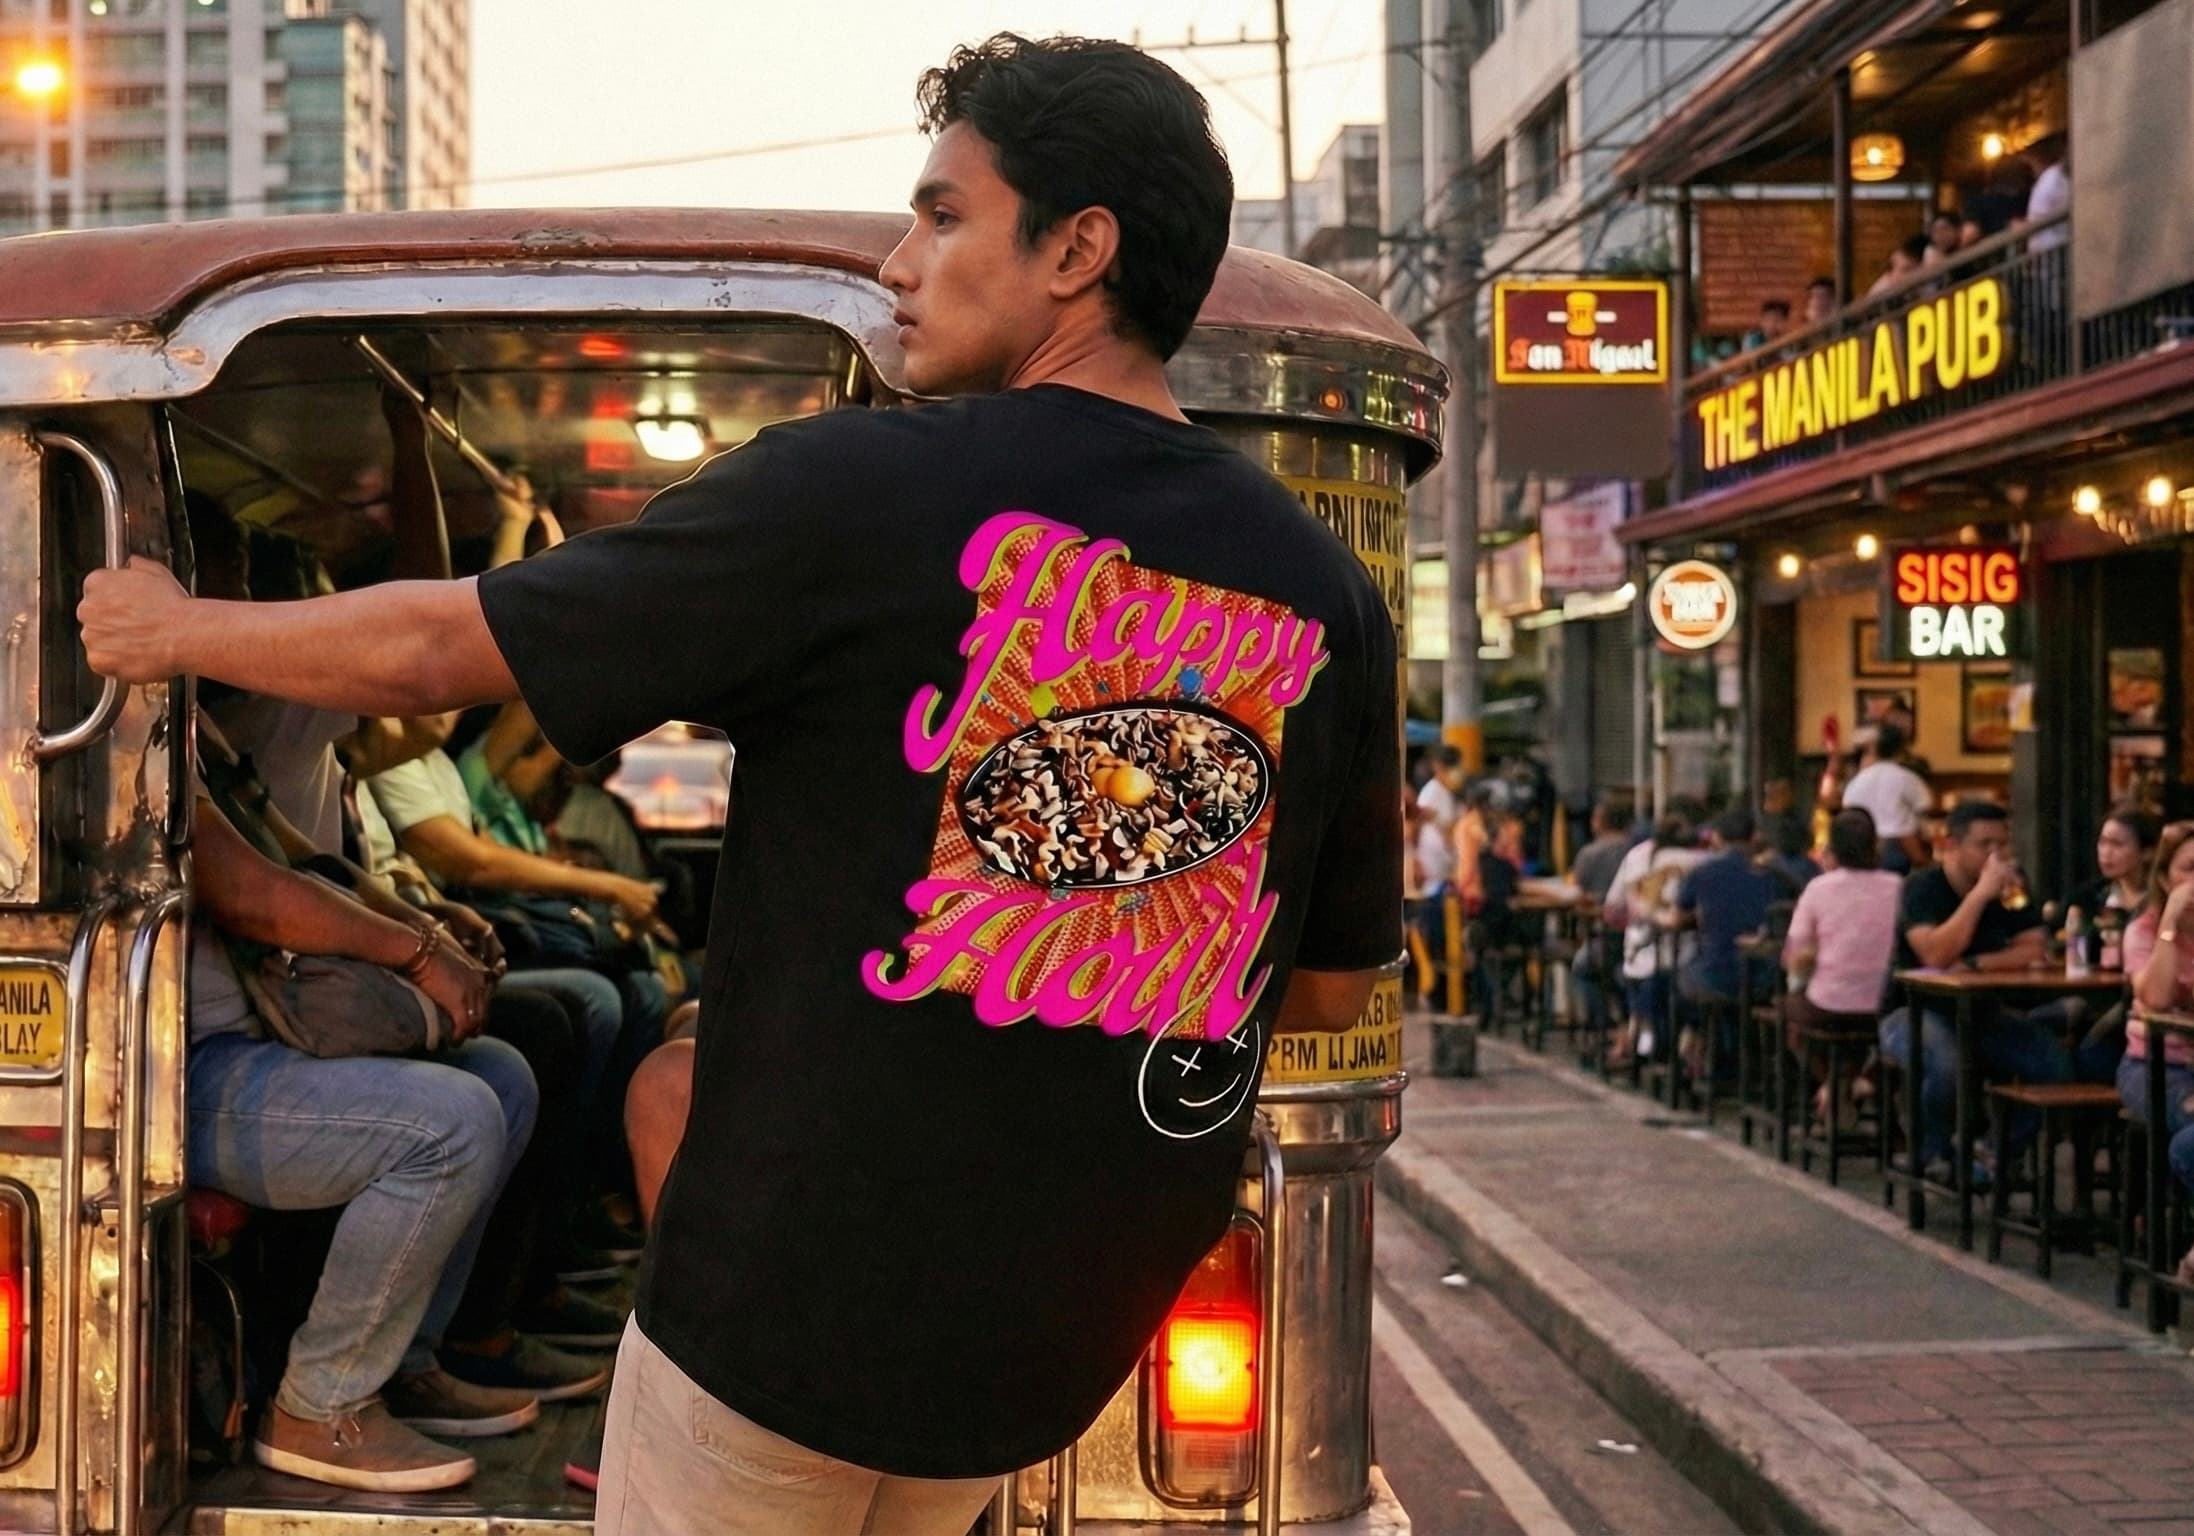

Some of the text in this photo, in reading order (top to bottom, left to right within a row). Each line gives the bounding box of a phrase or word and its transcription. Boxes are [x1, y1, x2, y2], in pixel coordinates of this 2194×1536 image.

[1699, 278, 2001, 471] THE MANILA PUB
[1898, 552, 2018, 603] SISIG
[904, 511, 1328, 773] Happy
[1909, 605, 2006, 656] BAR
[0, 1022, 42, 1055] LAY
